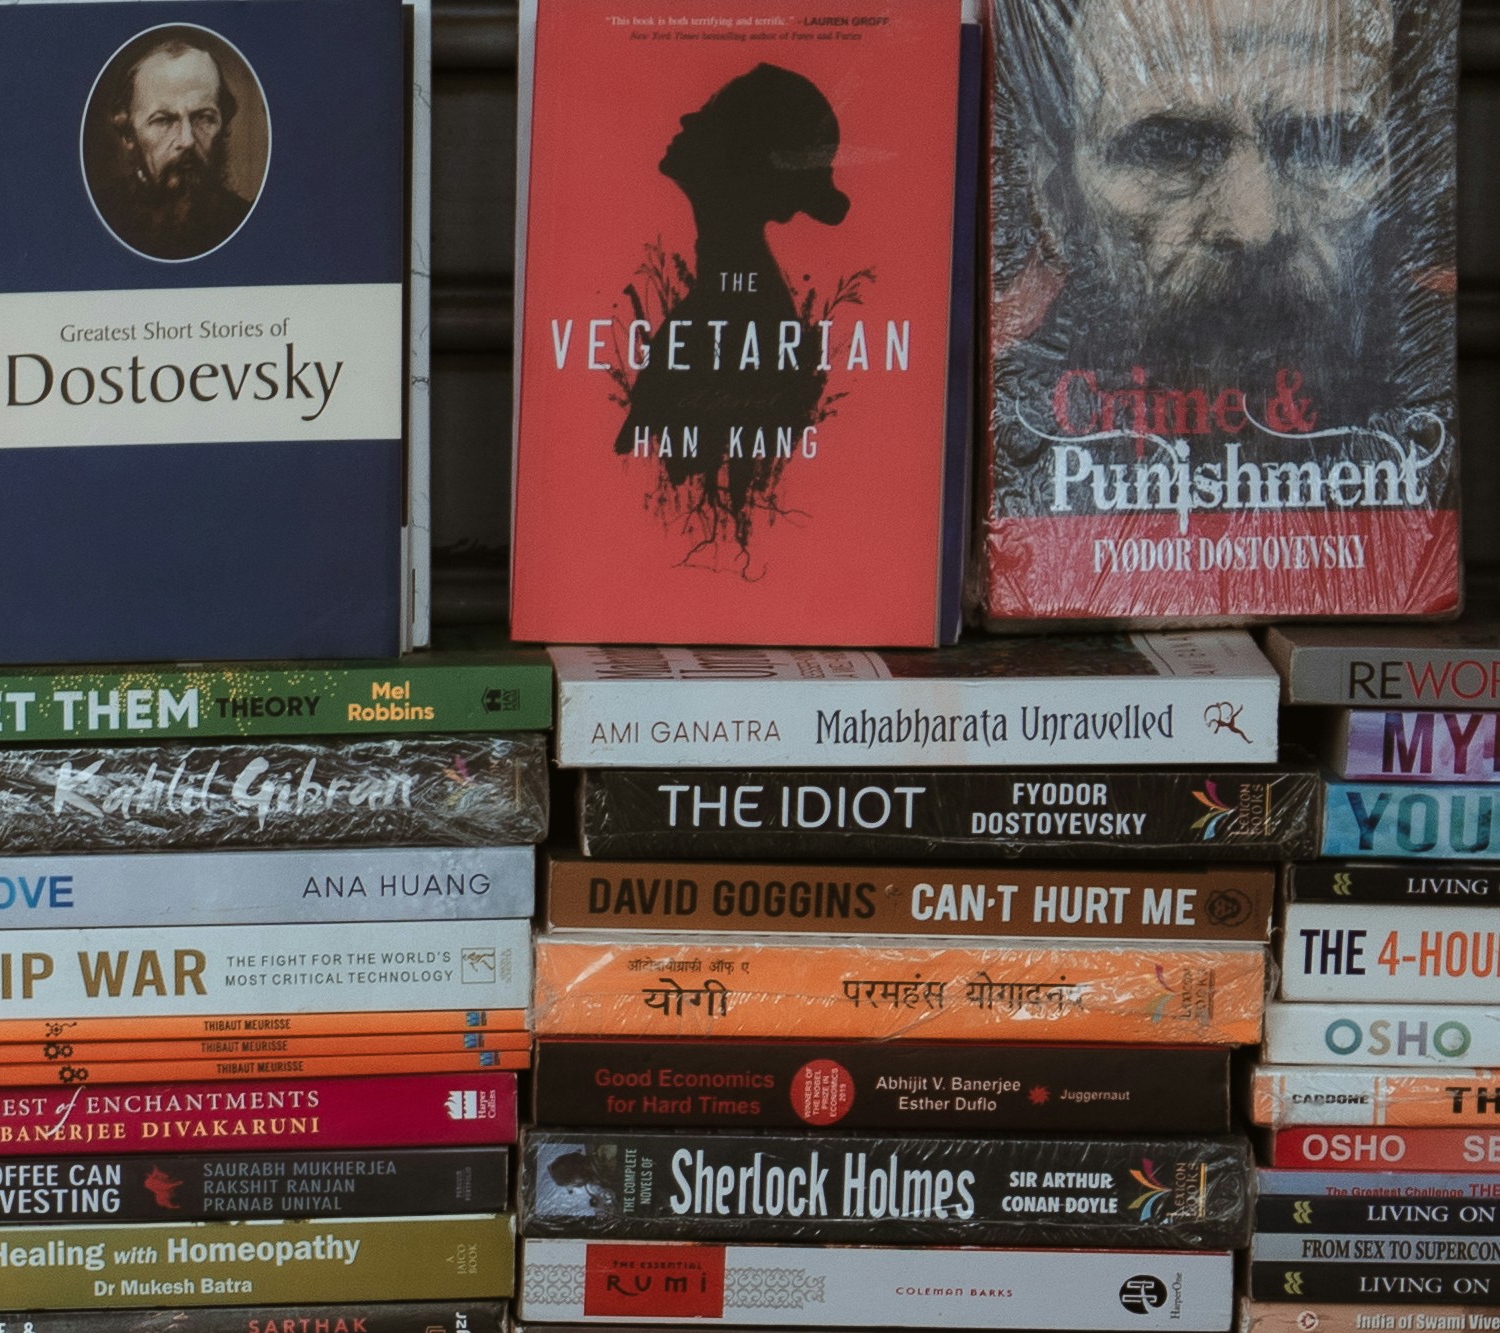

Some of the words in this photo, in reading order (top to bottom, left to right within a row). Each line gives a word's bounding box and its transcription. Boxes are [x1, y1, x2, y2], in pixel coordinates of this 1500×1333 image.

[720, 272, 759, 292] THE
[59, 320, 138, 344] Greatest
[144, 321, 193, 341] Short
[200, 320, 264, 341] Stories
[270, 318, 291, 339] of
[551, 320, 912, 372] VEGETARIAN
[4, 345, 345, 420] Dostoevsky
[634, 426, 700, 460] HAN
[730, 426, 820, 461] KANG
[1050, 440, 1428, 532] Punishment
[816, 707, 1009, 749] Mahabharata
[1020, 706, 1173, 743] Unravelled
[658, 785, 762, 828] THE
[780, 785, 927, 828] IDIOT
[79, 950, 208, 997] WAR
[670, 1149, 828, 1218] Sherlock
[843, 1152, 976, 1221] Holmes
